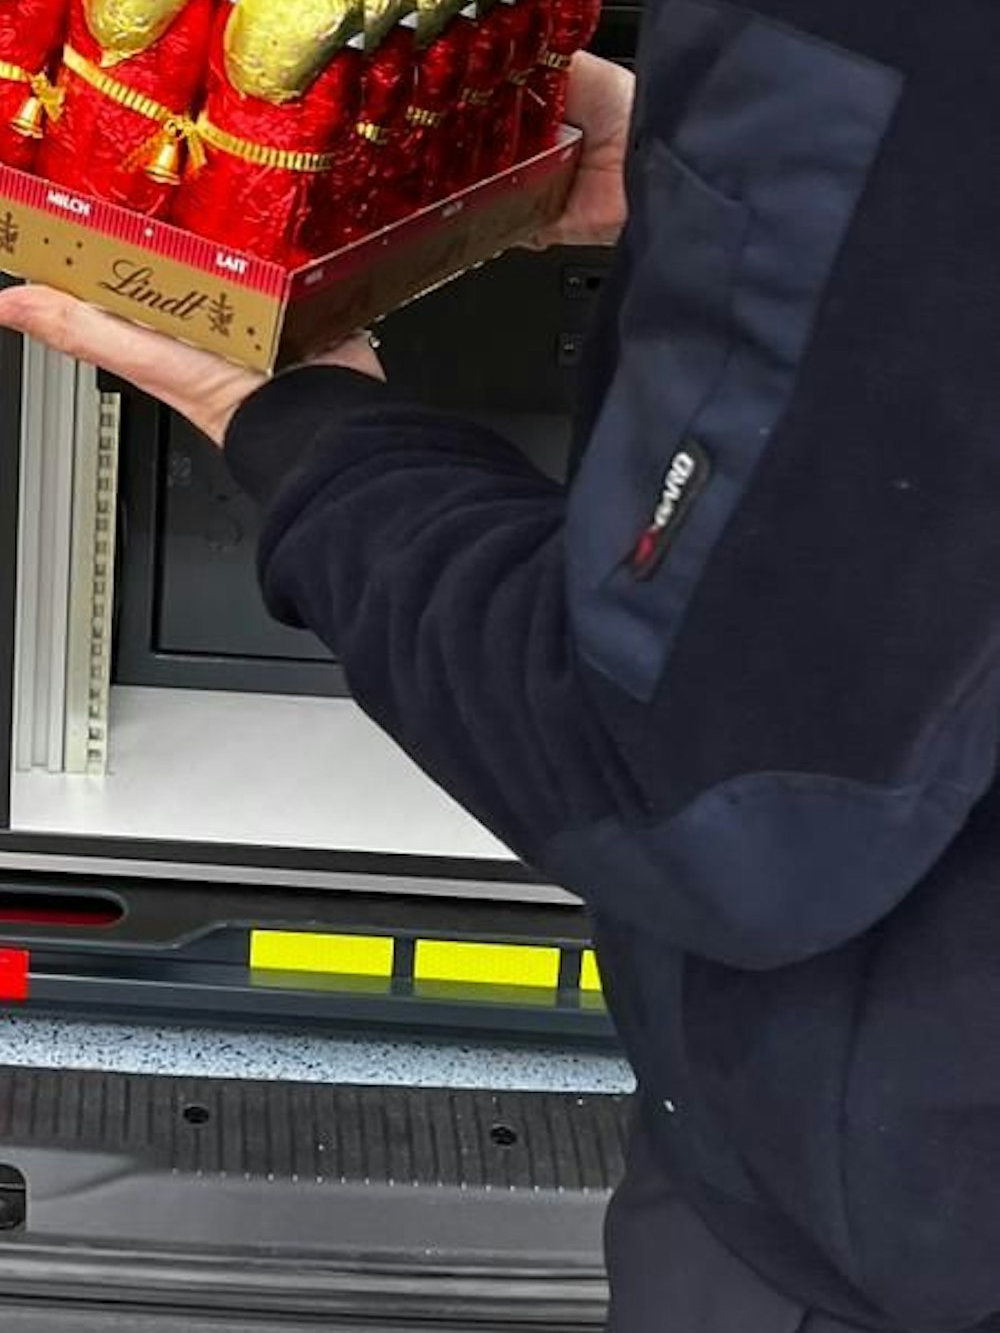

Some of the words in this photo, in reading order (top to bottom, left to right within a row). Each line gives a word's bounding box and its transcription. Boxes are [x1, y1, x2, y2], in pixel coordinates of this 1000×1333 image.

[47, 189, 91, 217] MILCH
[216, 253, 249, 275] LAIT
[100, 259, 202, 321] Lindt
